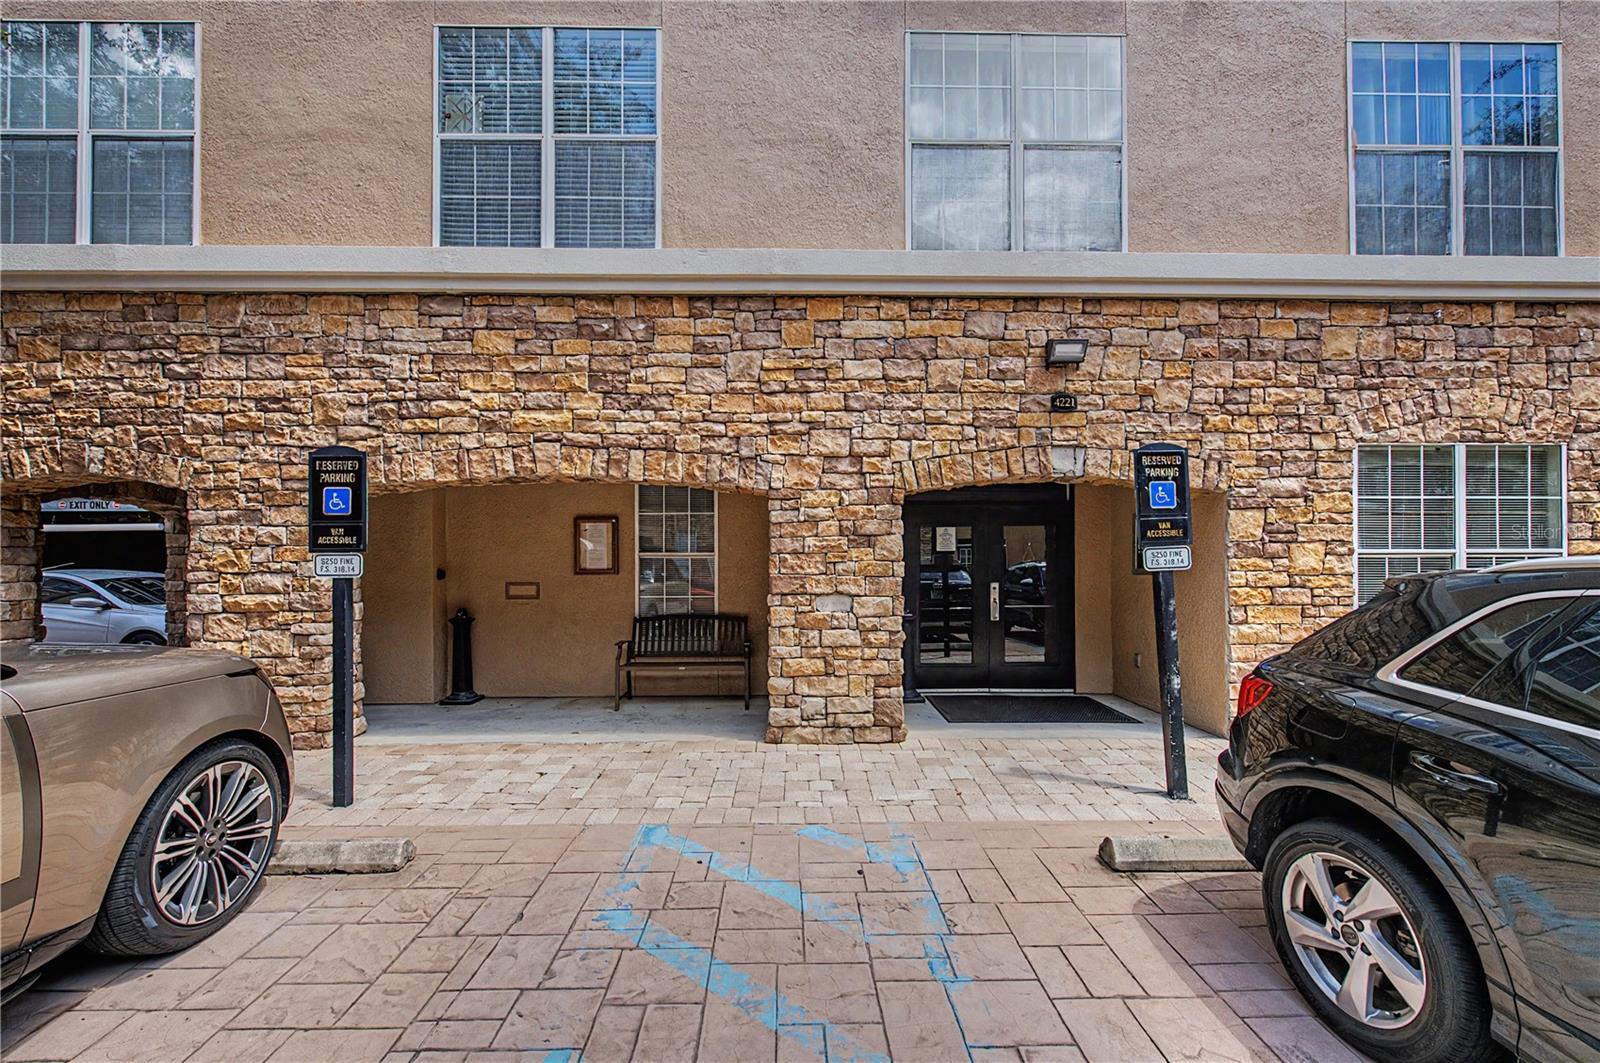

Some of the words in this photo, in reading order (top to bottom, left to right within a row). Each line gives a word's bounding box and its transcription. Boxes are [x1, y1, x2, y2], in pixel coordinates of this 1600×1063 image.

[1053, 397, 1075, 407] 4221
[1141, 455, 1182, 466] RESERVED
[315, 460, 359, 471] RESERVED
[1145, 467, 1179, 478] PARKING
[319, 472, 356, 483] PARKING
[69, 500, 88, 510] EXIT
[89, 500, 111, 510] ONLY
[1157, 521, 1171, 529] VAN
[330, 527, 345, 536] VAN
[1146, 529, 1184, 538] ACCESSIBLE
[317, 536, 357, 544] ACCESSIBLE
[1151, 551, 1168, 559] $250
[1169, 550, 1183, 558] FINE
[320, 557, 338, 565] $250
[340, 557, 355, 565] FINE
